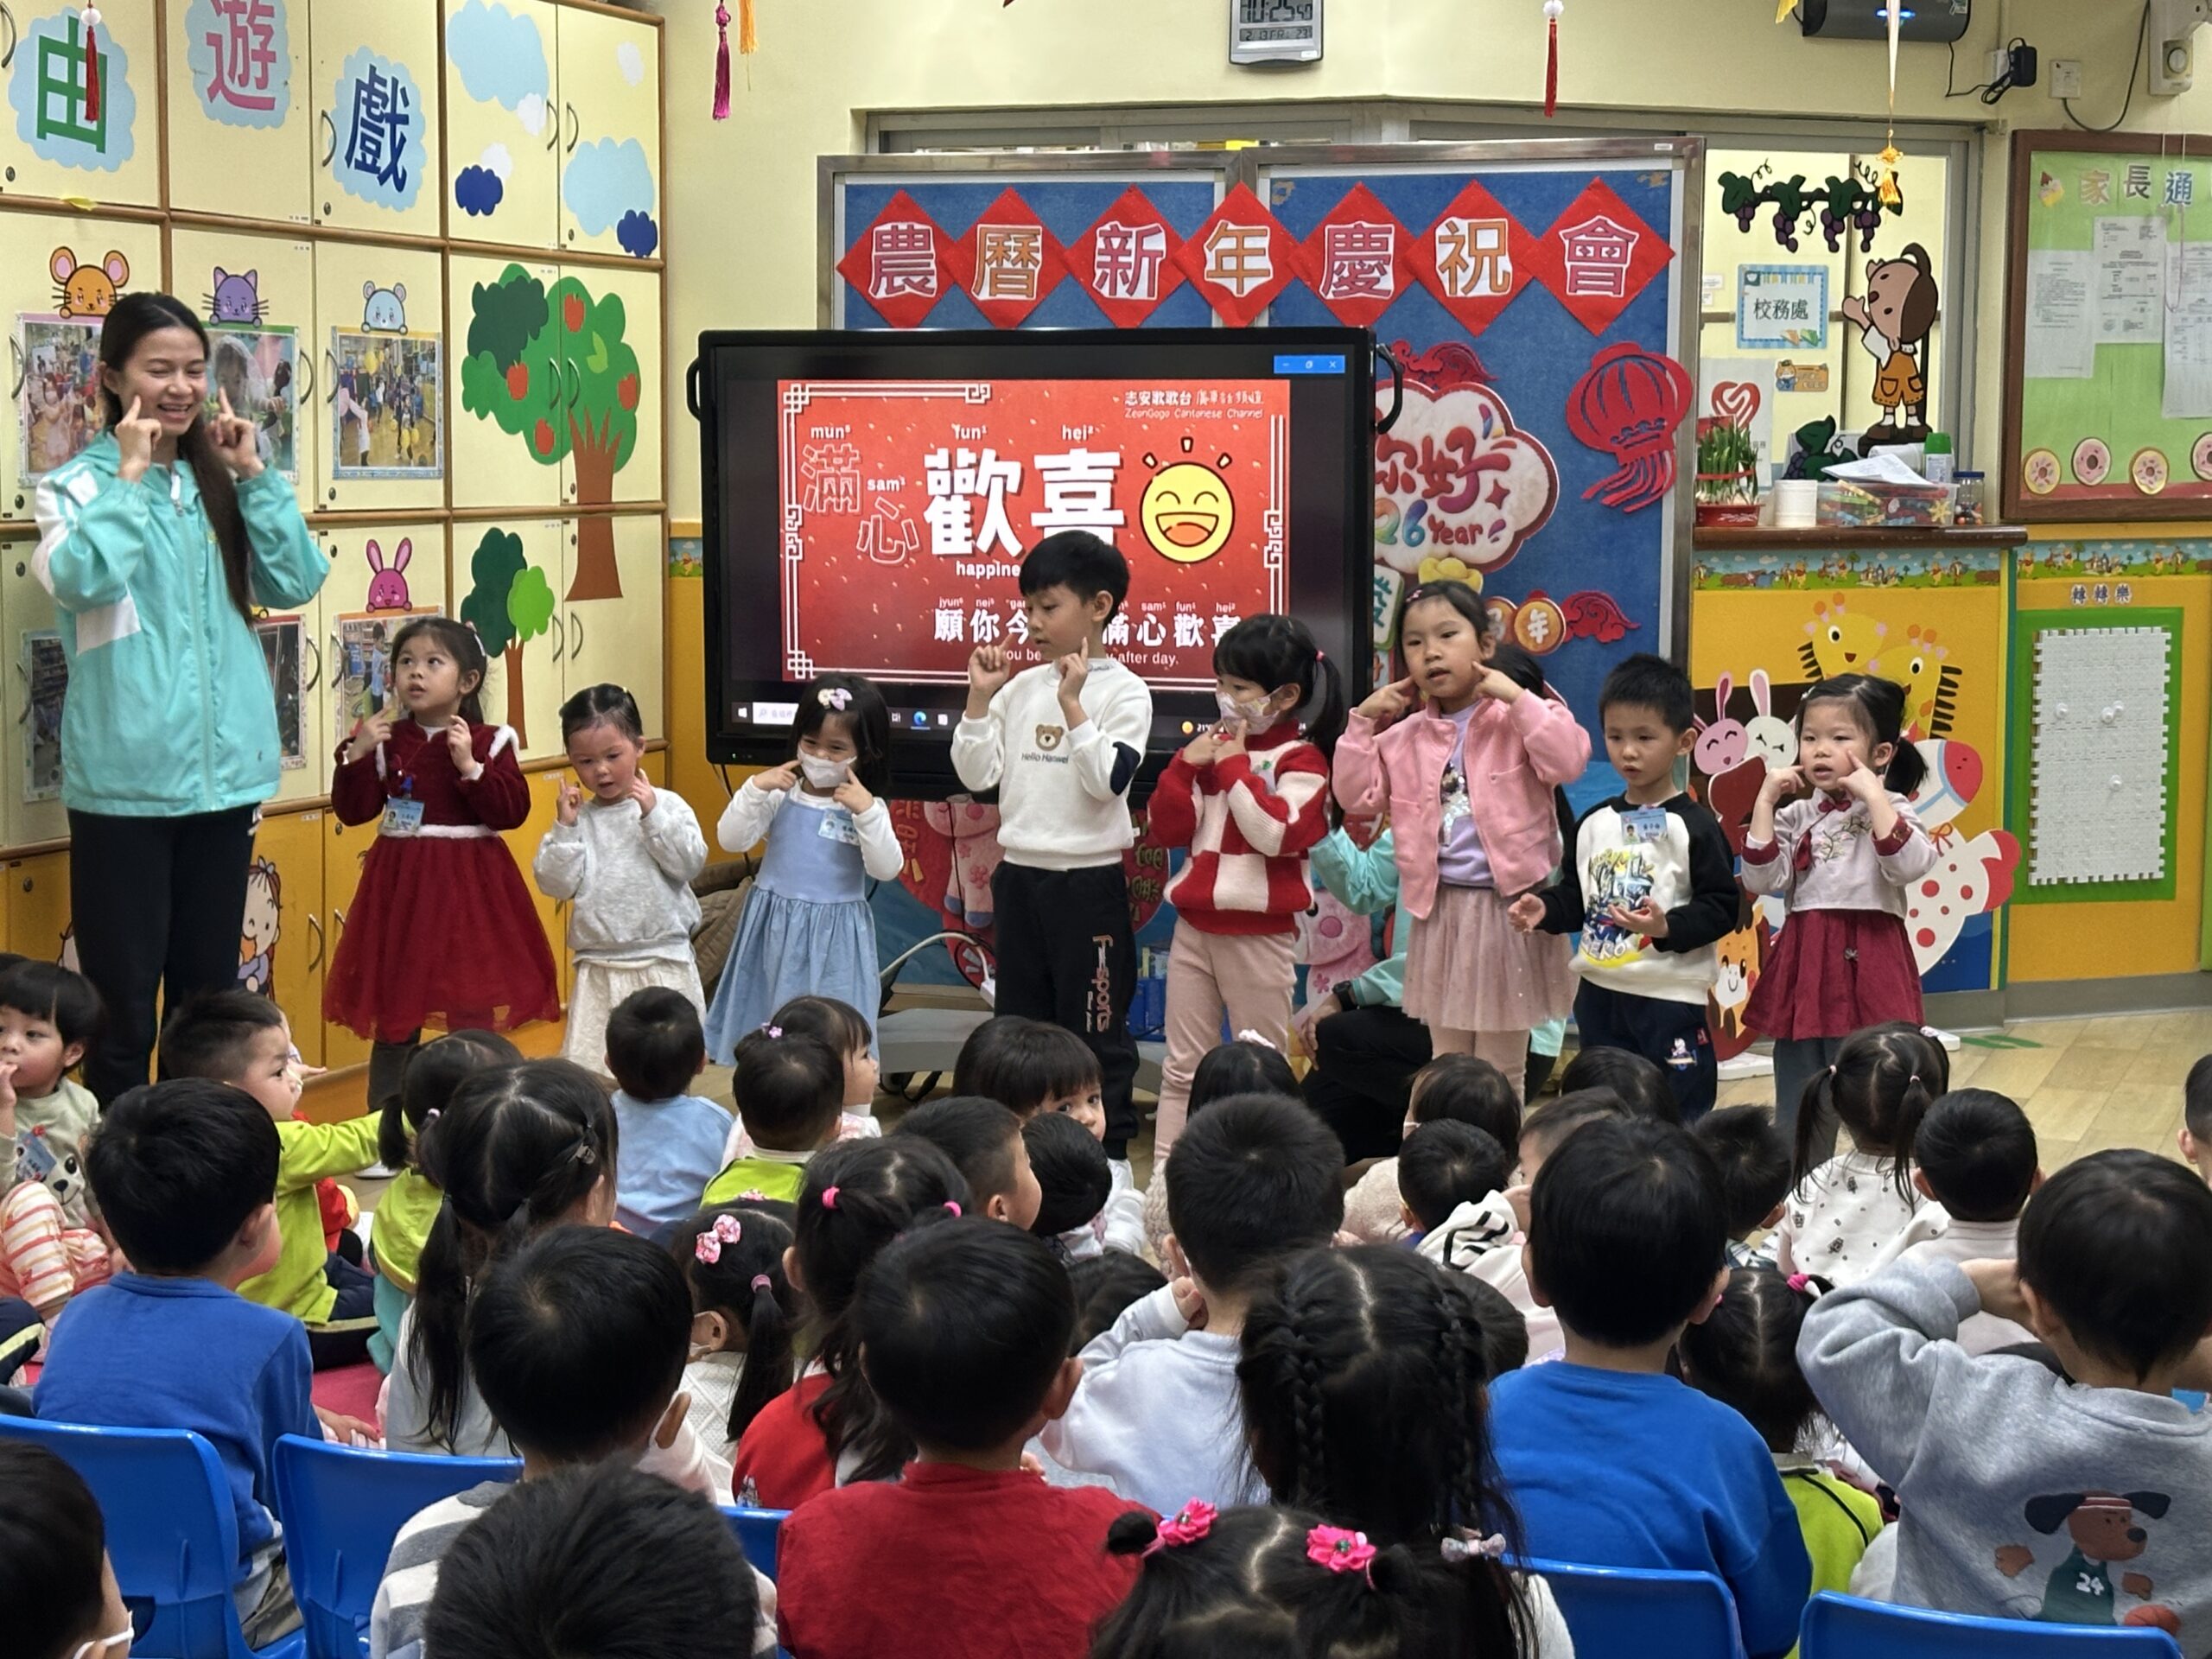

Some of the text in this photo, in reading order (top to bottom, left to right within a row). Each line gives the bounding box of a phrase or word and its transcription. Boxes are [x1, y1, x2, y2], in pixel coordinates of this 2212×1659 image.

[869, 219, 1639, 300] 農曆新年慶祝會
[1753, 298, 1808, 321] 校務處
[1174, 408, 1222, 419] Cantonese
[1227, 408, 1263, 419] Channel
[1375, 498, 1484, 547] 26 Year
[956, 560, 1021, 579] happine
[2075, 1572, 2105, 1596] 24
